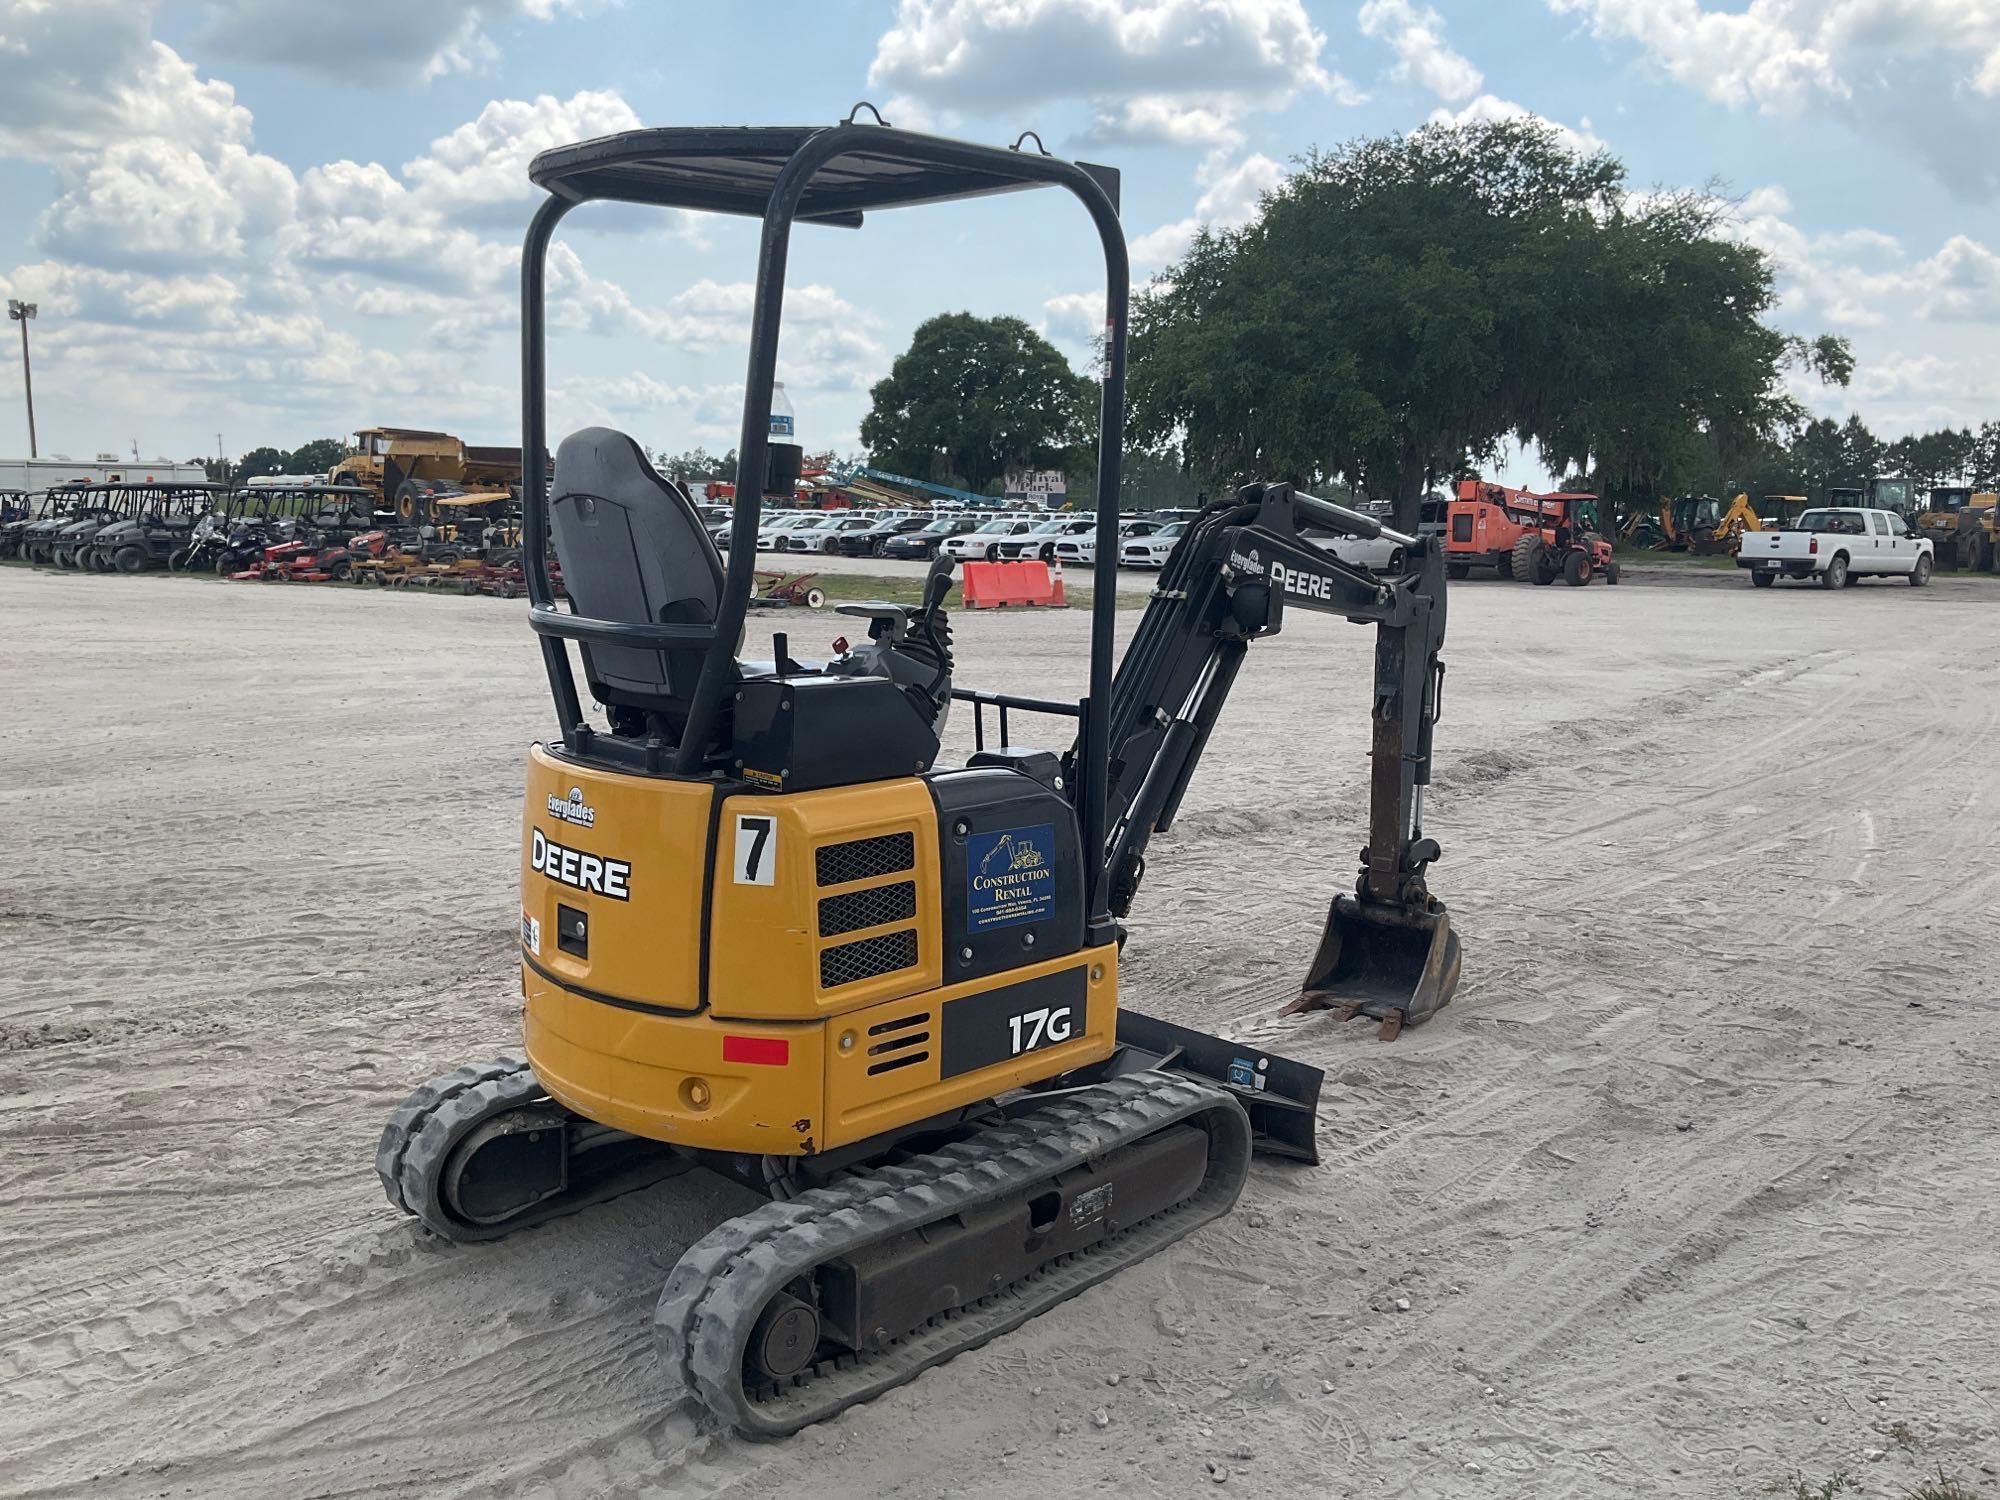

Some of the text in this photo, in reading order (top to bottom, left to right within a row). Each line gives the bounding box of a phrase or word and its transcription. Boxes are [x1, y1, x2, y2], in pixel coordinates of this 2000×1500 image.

[1020, 482, 1053, 492] Park
[1230, 550, 1264, 574] Everglades
[1269, 561, 1333, 600] DEERE
[548, 793, 595, 822] Everglades
[532, 828, 630, 899] DEERE
[740, 817, 771, 882] 7
[995, 886, 1032, 902] RENTAL
[1009, 1007, 1071, 1054] 17G
